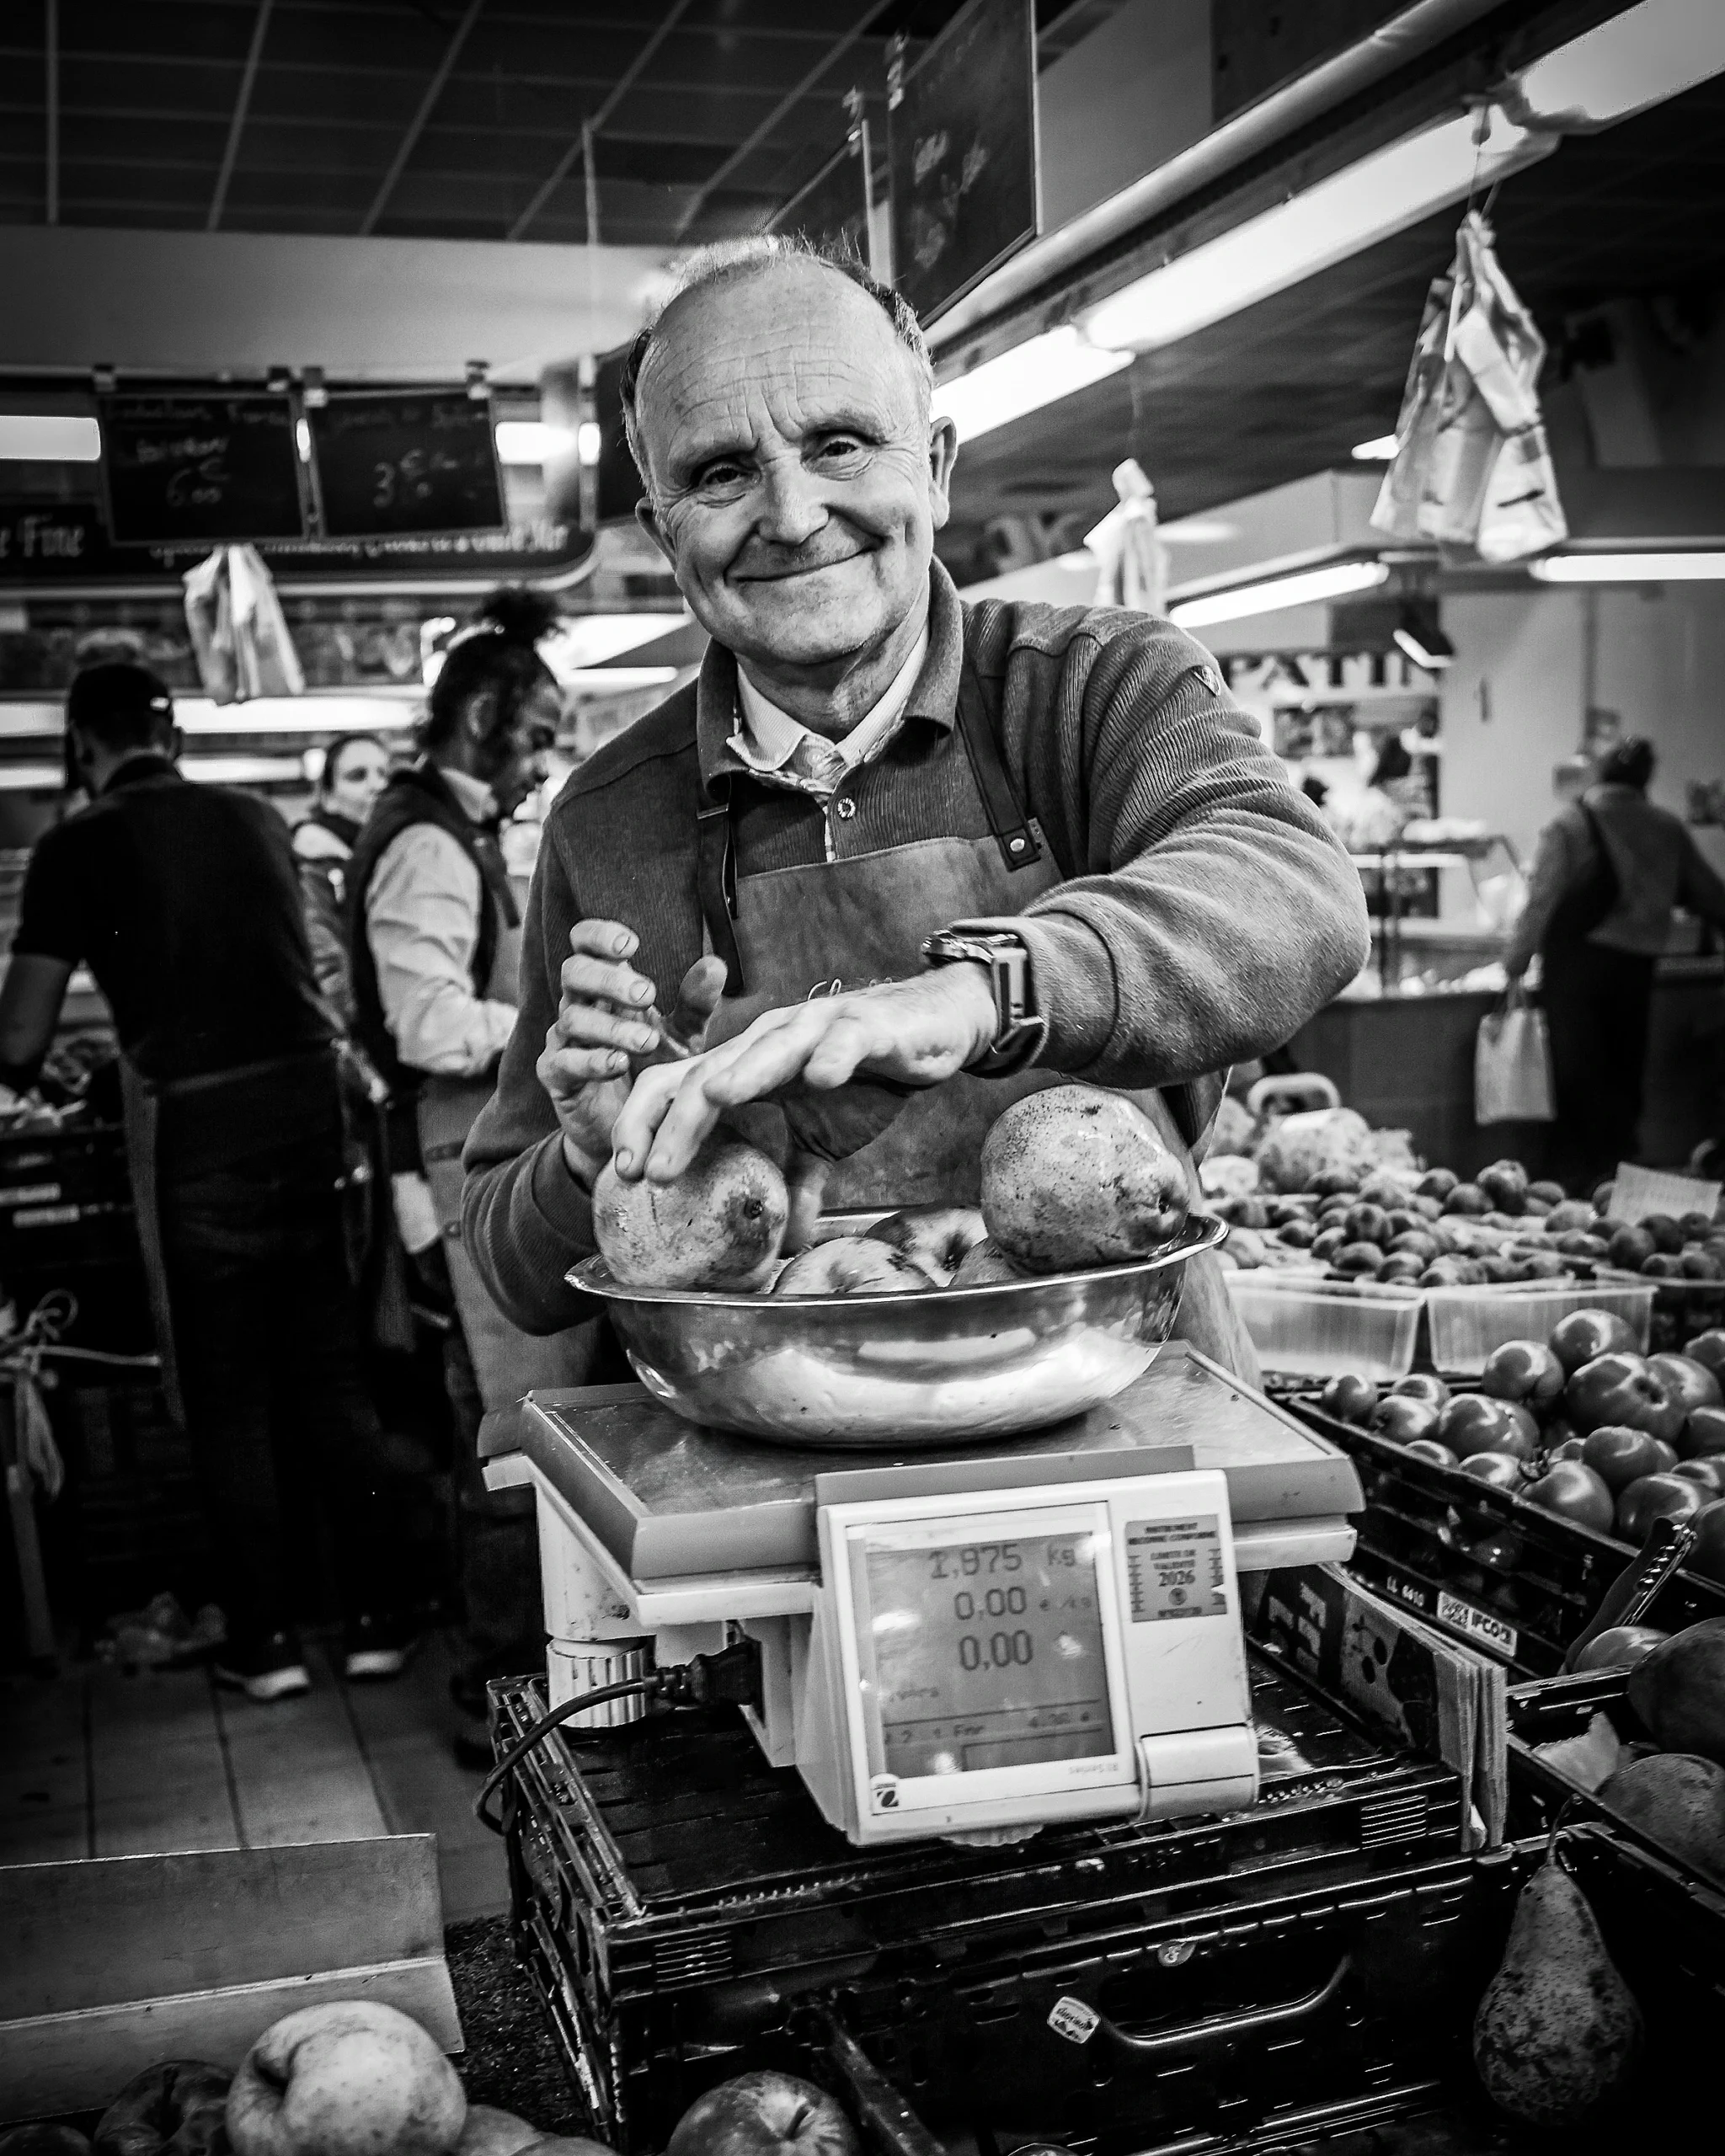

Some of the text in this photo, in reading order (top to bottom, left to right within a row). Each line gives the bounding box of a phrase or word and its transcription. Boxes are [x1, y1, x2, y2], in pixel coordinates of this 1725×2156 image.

[1046, 1546, 1076, 1567] kg
[953, 1585, 1028, 1621] 0,00
[959, 1629, 1033, 1672] 0,00
